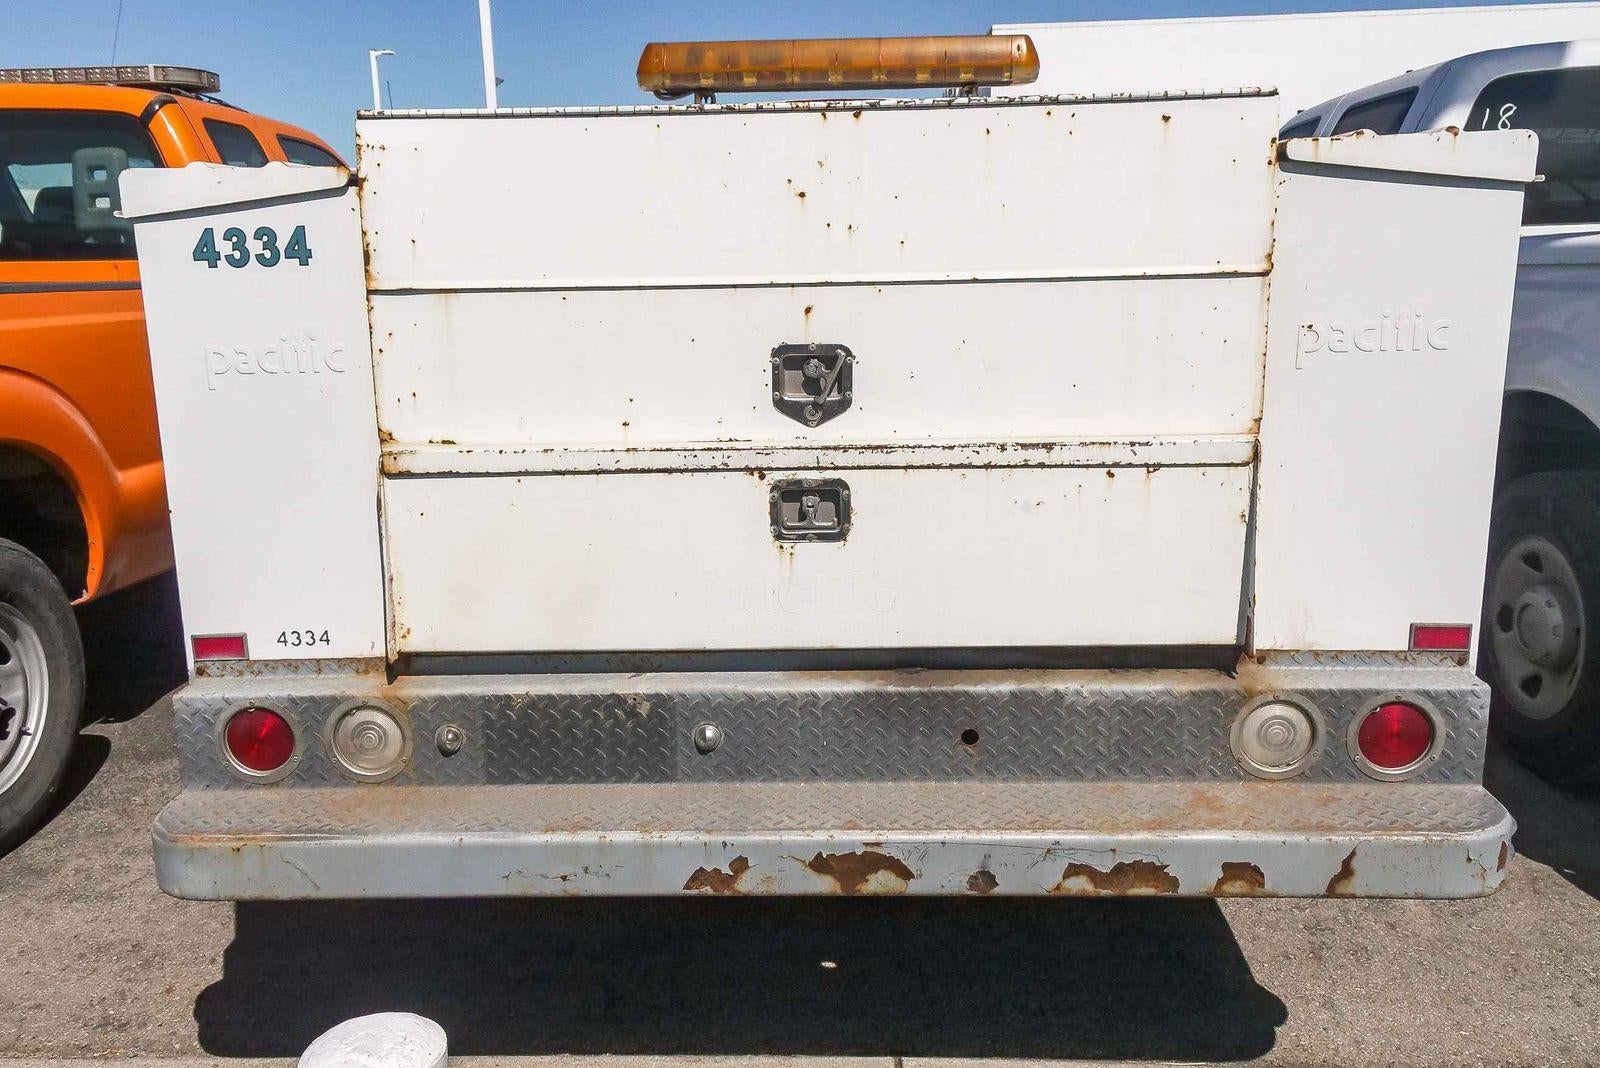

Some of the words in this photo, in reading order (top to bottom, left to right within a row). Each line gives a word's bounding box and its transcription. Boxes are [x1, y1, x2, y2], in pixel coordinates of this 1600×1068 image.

[1482, 103, 1517, 130] 18
[192, 225, 313, 269] 4334
[277, 630, 331, 647] 4334
